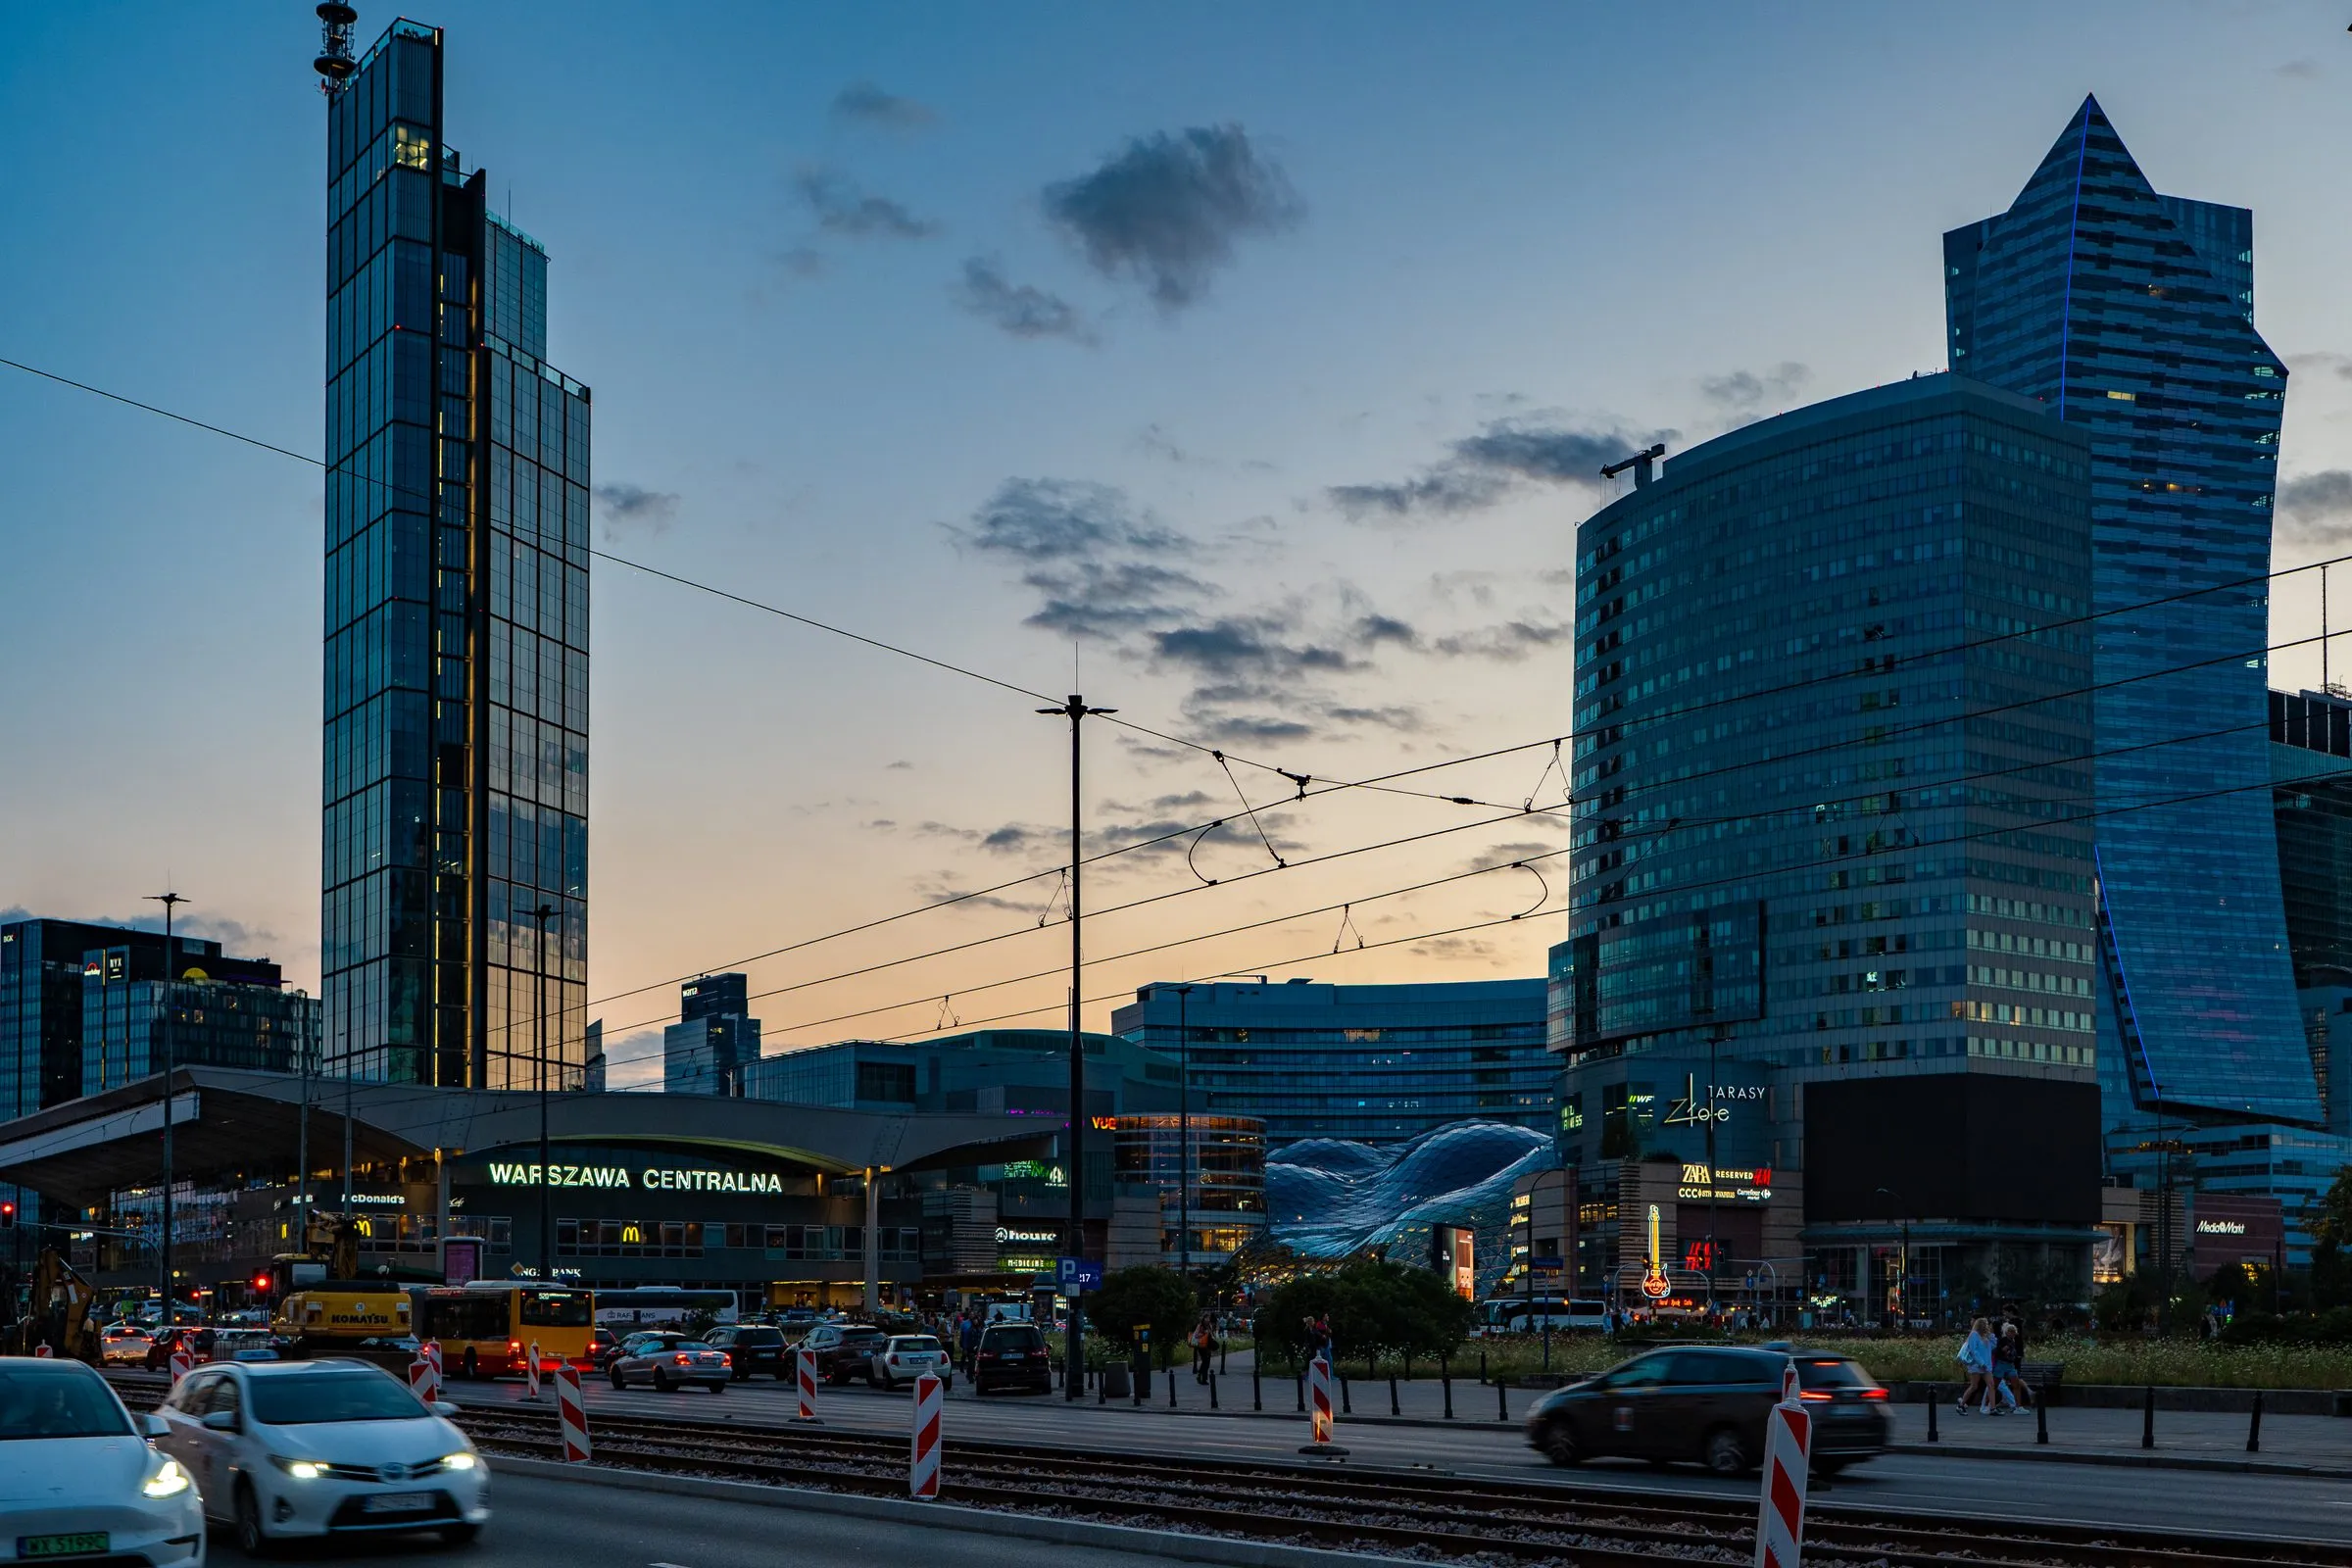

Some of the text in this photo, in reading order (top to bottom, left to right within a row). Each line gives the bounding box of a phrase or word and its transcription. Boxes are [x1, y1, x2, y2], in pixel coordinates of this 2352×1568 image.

[1708, 1085, 1764, 1100] TARASY
[488, 1162, 783, 1194] WARSZAWA CENTRALNA
[1682, 1164, 1712, 1184] ZARA
[1715, 1170, 1753, 1180] RESERVED
[1679, 1188, 1698, 1199] CCC
[552, 1268, 581, 1277] BANK
[1061, 1259, 1076, 1281] P
[331, 1314, 389, 1324] KOMATSU
